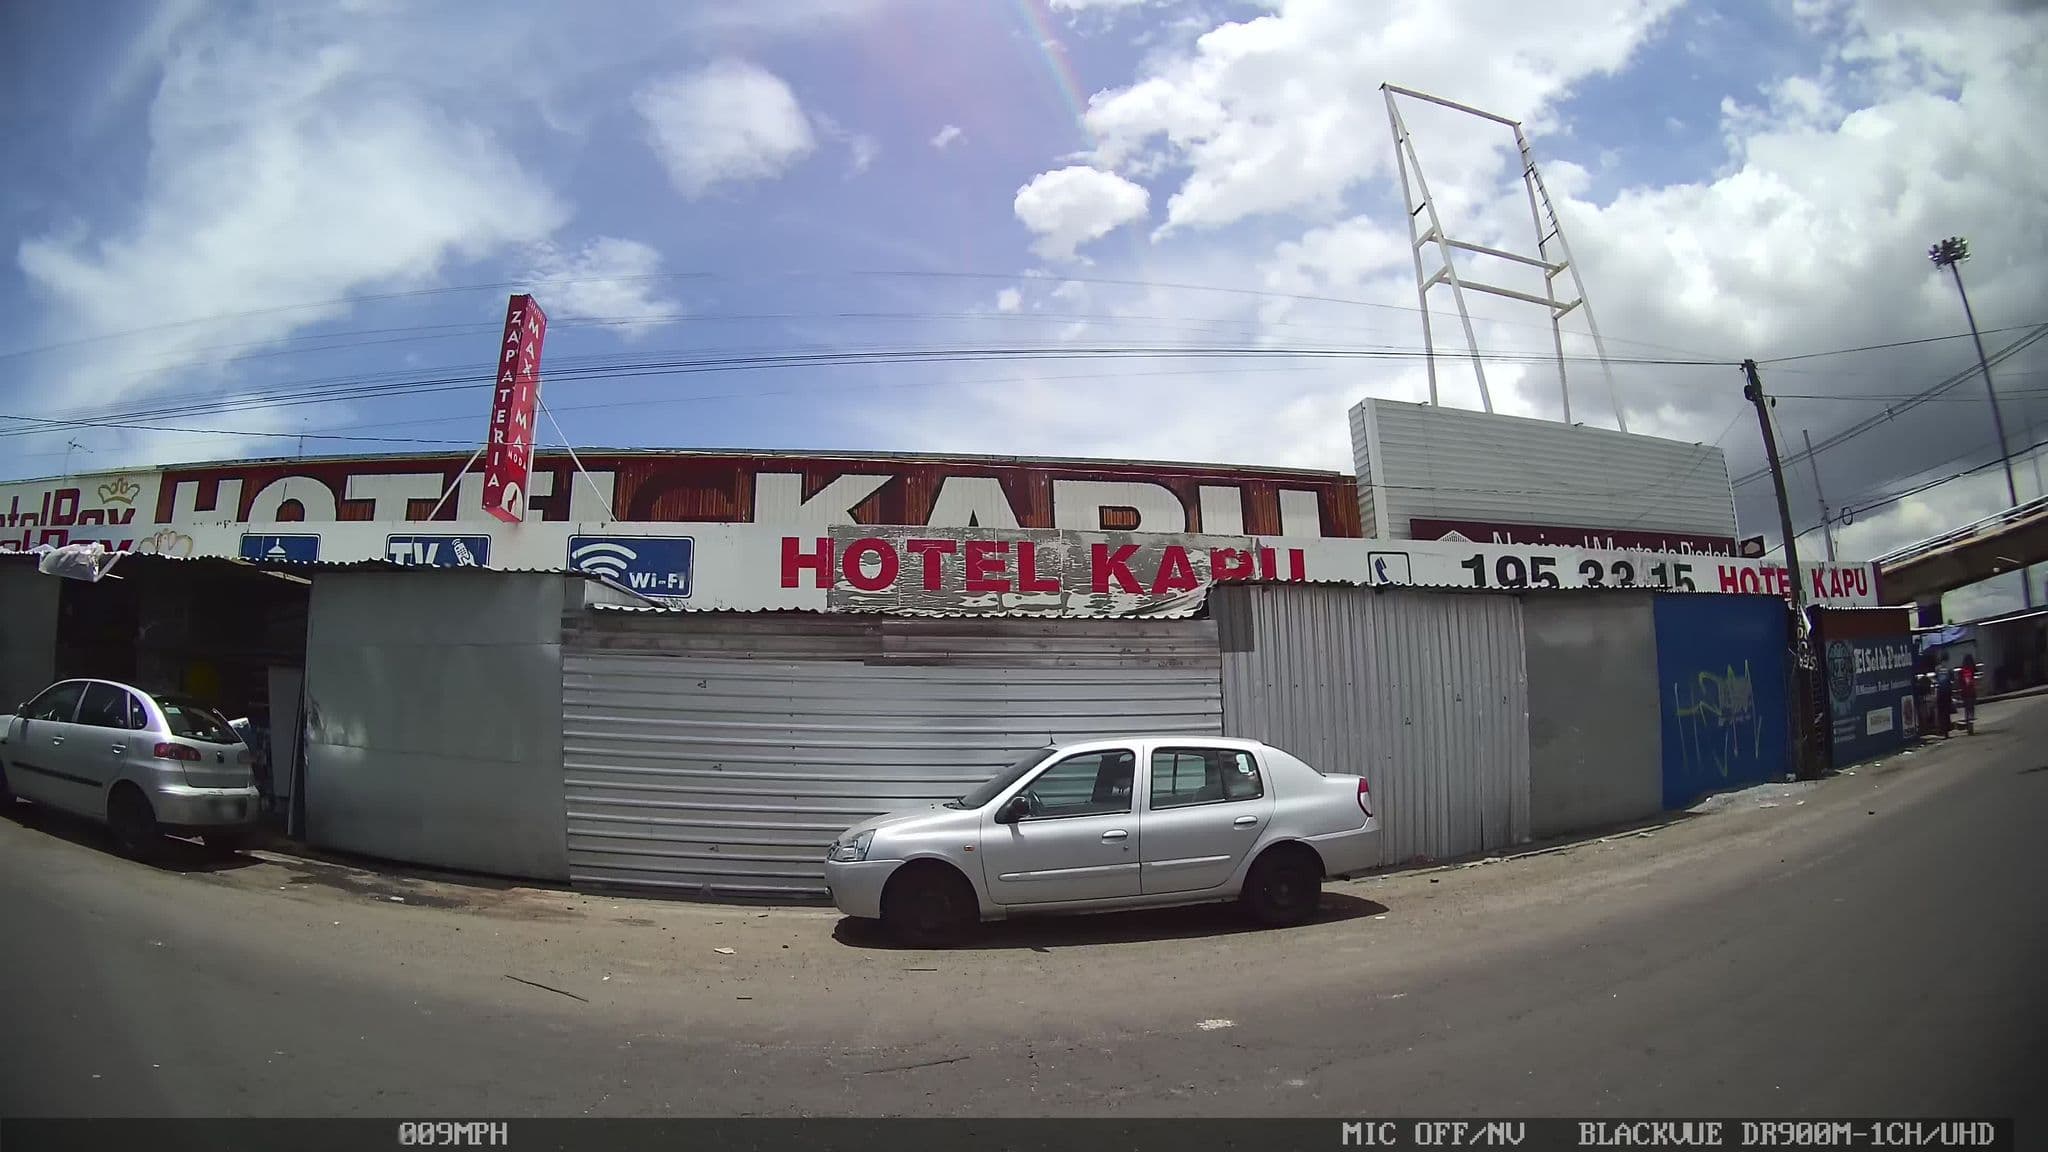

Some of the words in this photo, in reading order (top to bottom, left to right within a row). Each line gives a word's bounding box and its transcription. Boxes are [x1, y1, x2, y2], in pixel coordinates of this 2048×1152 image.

[488, 311, 522, 487] ZAPATERIA
[513, 316, 539, 453] MAXIMA
[390, 542, 440, 568] TV
[781, 537, 1061, 593] HOTEL
[1091, 543, 1306, 595] KAPU
[1461, 554, 1560, 588] 195
[1651, 562, 1697, 591] 15
[629, 572, 685, 589] Wi-Fi
[1718, 565, 1792, 600] HOTE
[1811, 566, 1868, 598] KAPU
